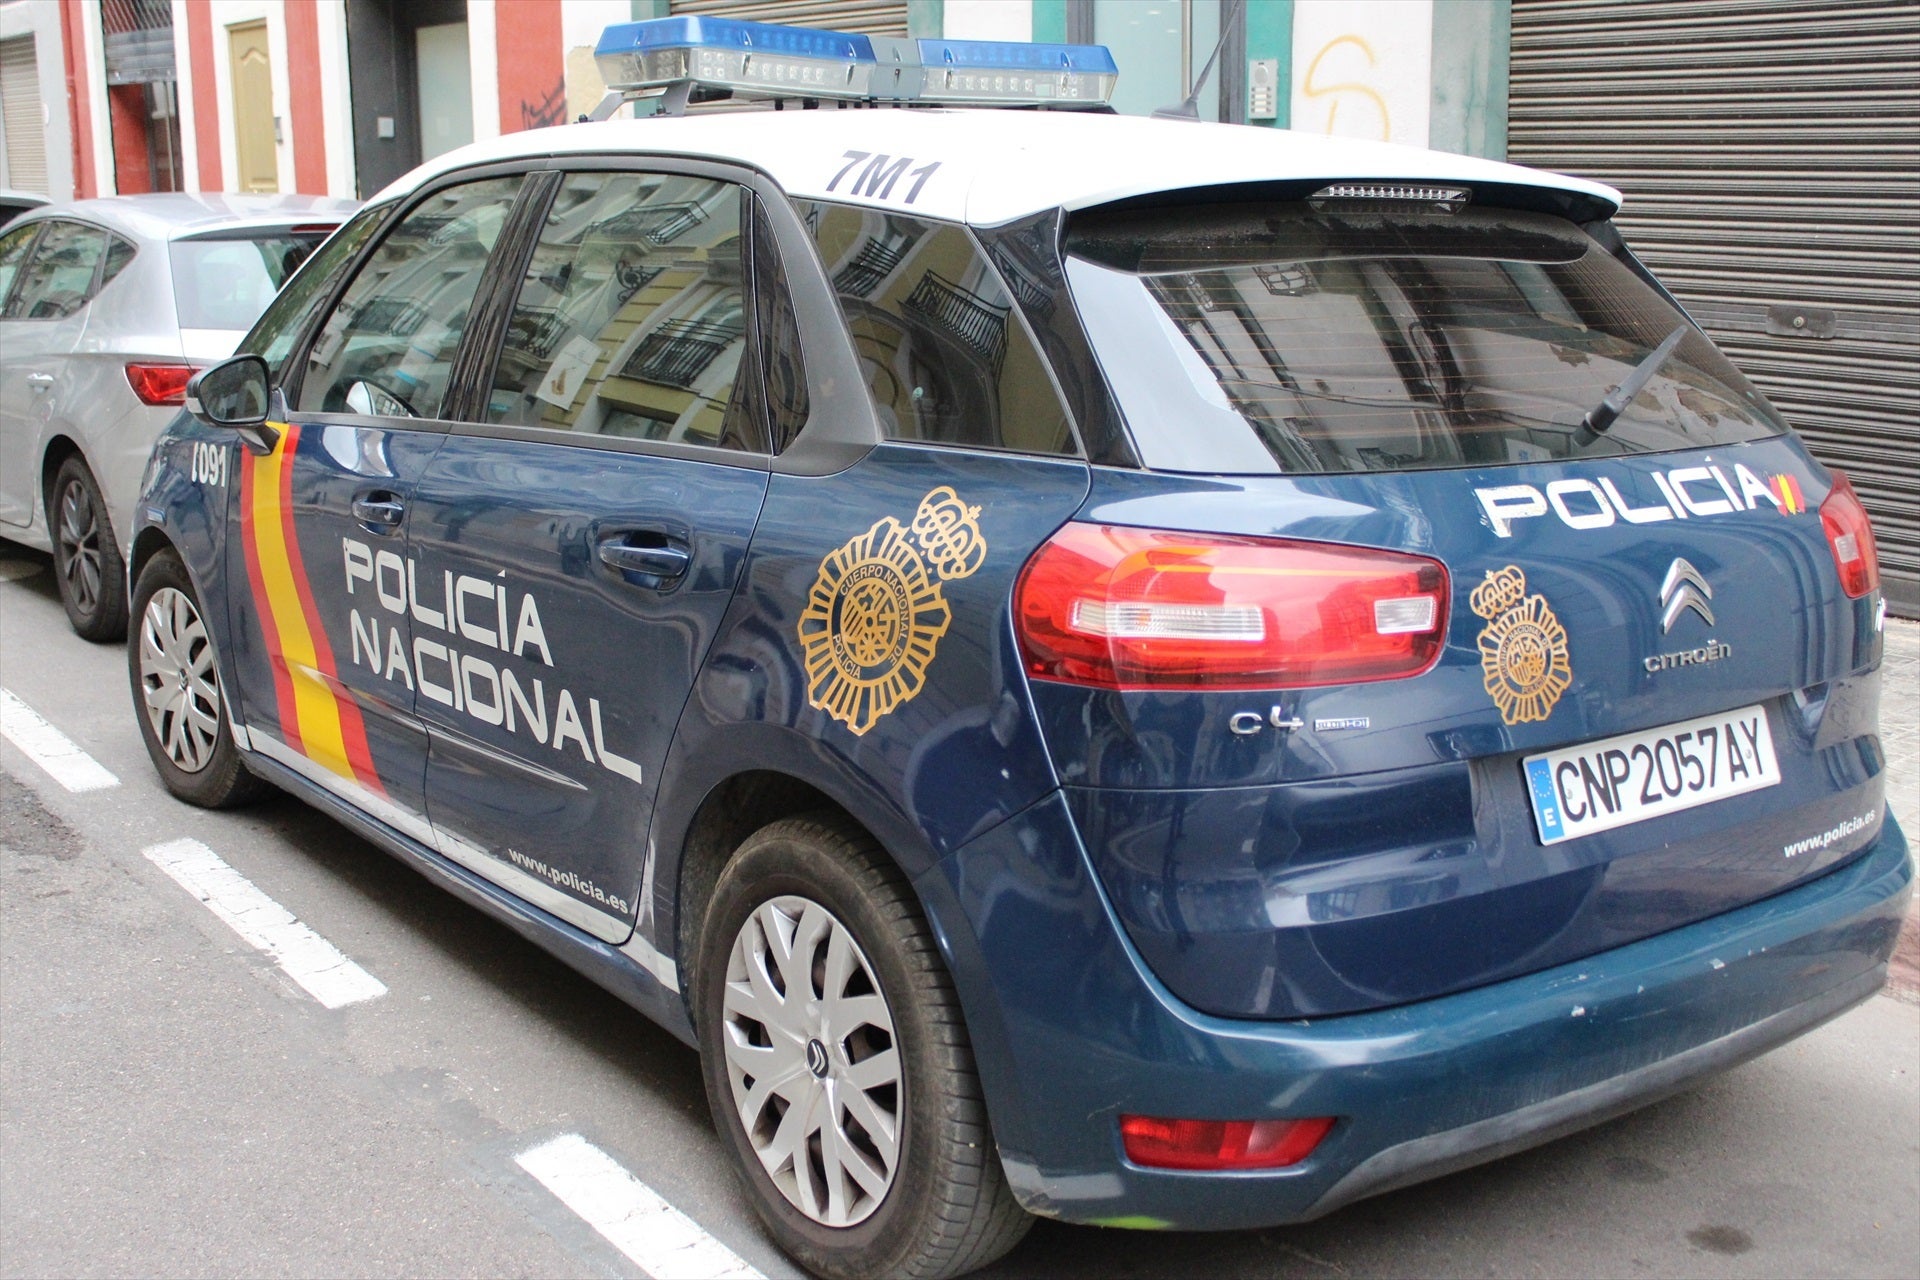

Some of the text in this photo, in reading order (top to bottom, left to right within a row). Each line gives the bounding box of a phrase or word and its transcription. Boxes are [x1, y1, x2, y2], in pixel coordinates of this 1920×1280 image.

[826, 149, 943, 204] 7M1
[1474, 455, 1782, 538] POLICÍA
[342, 537, 555, 668] POLICÍA
[840, 564, 910, 668] CUERPO NACIONAL DE
[350, 608, 643, 785] NACIONAL
[1229, 705, 1304, 735] C4
[1543, 807, 1557, 827] E
[1783, 809, 1876, 858] www.policia.es
[508, 848, 629, 915] www.policia.es
